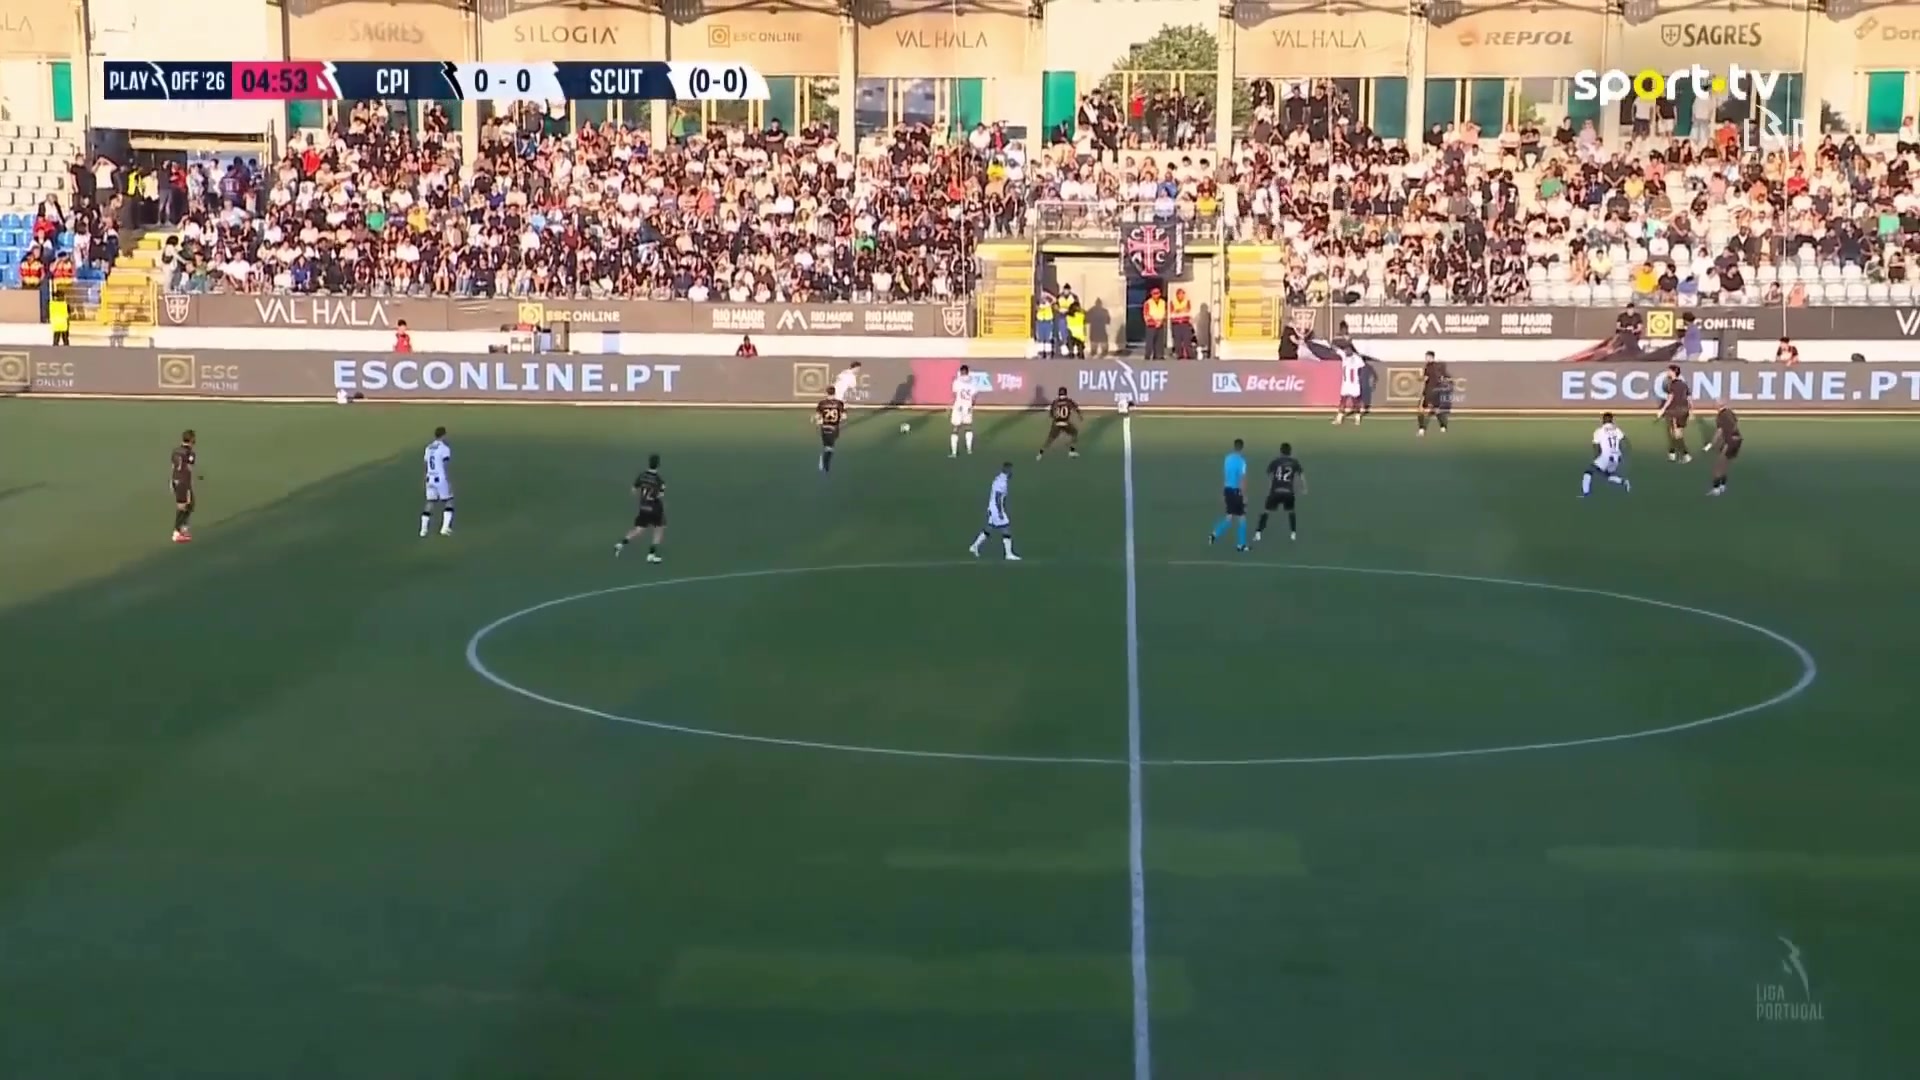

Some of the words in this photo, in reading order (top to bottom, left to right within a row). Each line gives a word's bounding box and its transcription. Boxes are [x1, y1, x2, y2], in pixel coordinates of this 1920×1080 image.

[1484, 31, 1574, 46] REPSOL
[1683, 24, 1762, 47] SAGRES
[573, 310, 620, 323] ONLINE
[1676, 318, 1703, 330] EC
[1704, 318, 1755, 330] ONLINE
[36, 362, 74, 377] ESC
[201, 365, 239, 380] ESC
[333, 359, 681, 393] ESCONLINE.PT
[1079, 369, 1118, 391] PLAY
[1140, 370, 1169, 391] OFF
[1246, 374, 1305, 391] Betclic
[823, 408, 839, 422] 29
[429, 455, 436, 470] 6
[1275, 465, 1293, 482] 42
